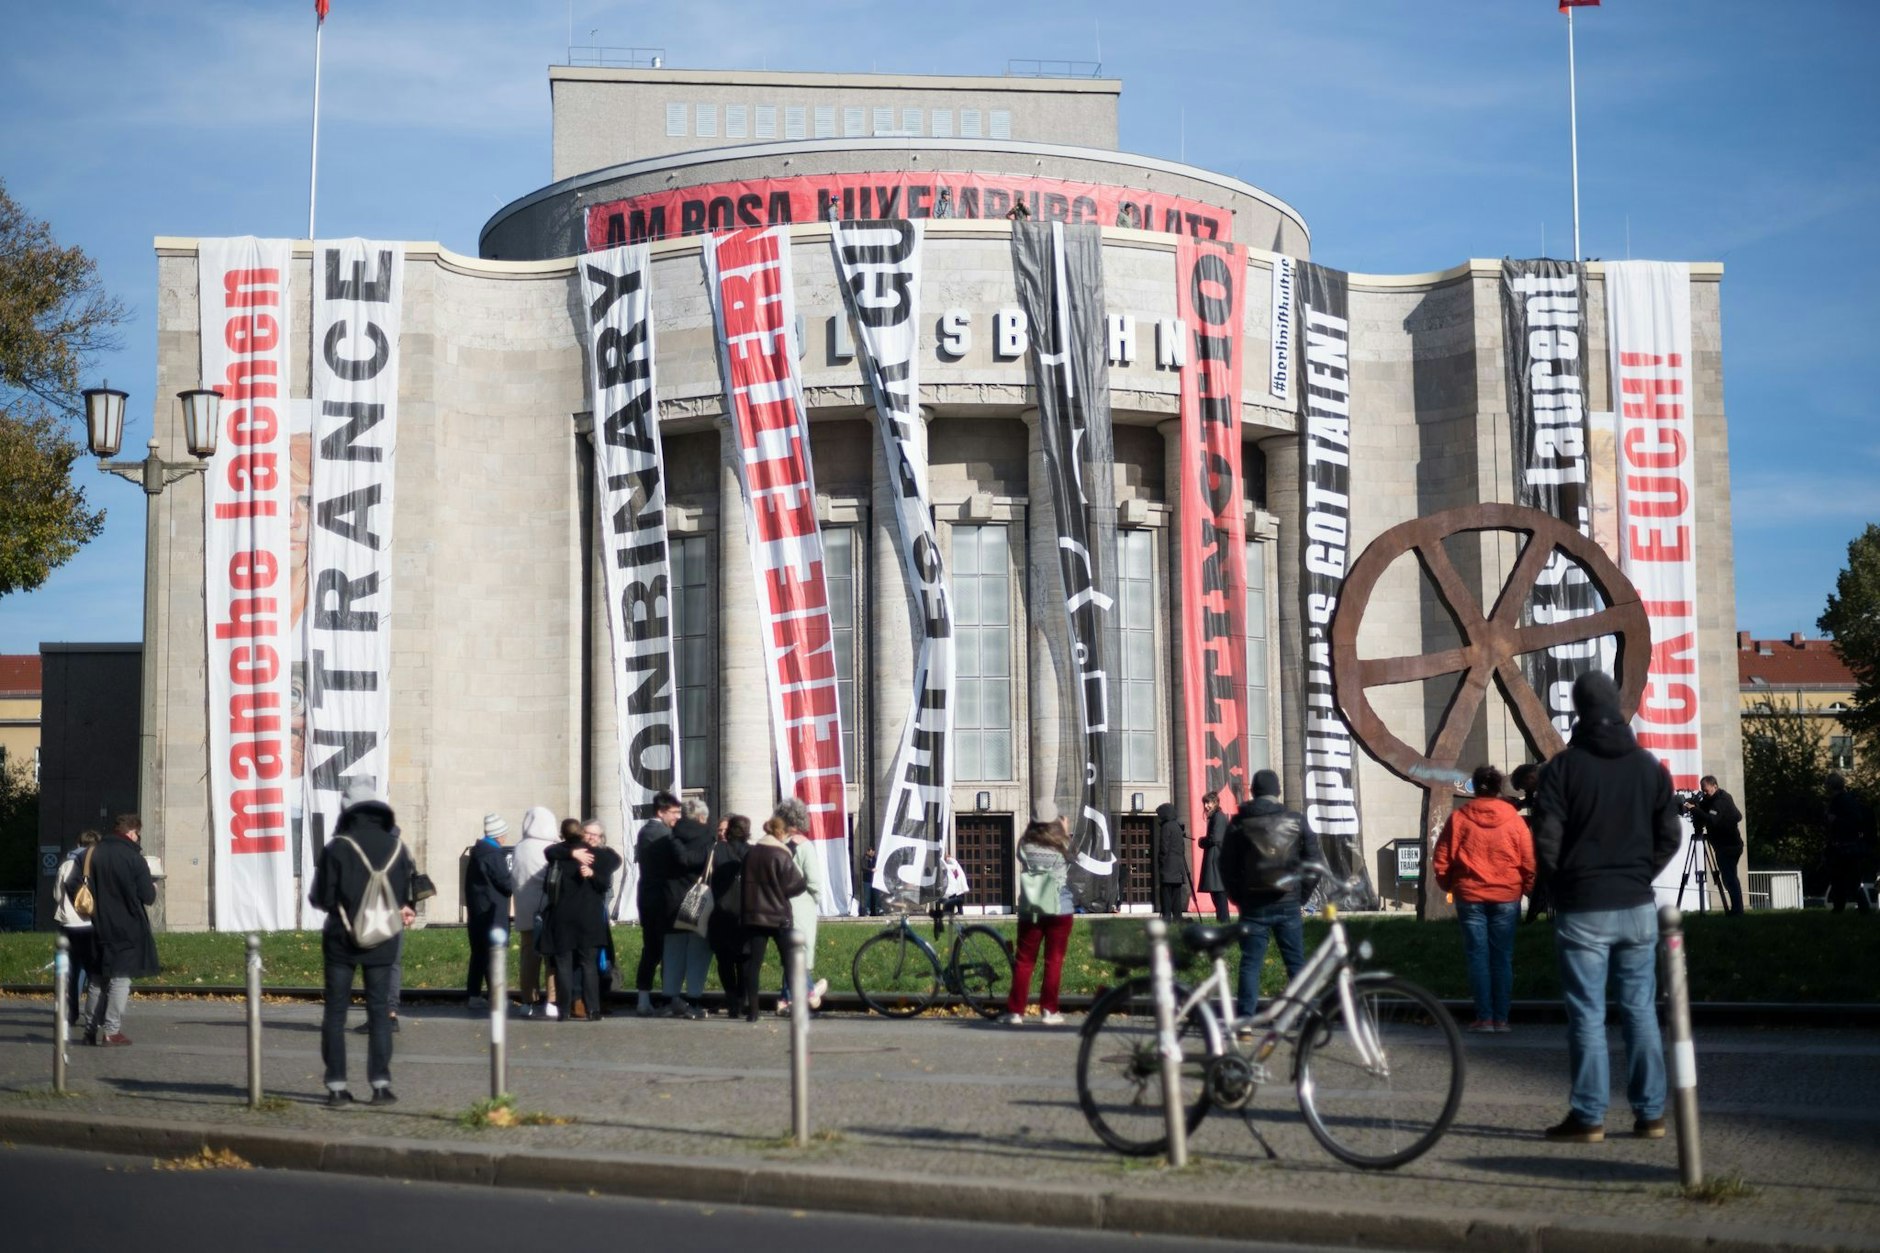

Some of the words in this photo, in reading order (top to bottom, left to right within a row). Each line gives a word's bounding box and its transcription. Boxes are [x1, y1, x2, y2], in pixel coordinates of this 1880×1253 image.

[607, 205, 665, 248] AM
[681, 190, 792, 237] ROSA
[212, 267, 280, 520] lachen
[712, 226, 817, 543] ELTERN
[1305, 302, 1349, 467] TALENT
[1512, 273, 1586, 486] Laurent
[1621, 351, 1691, 563] EUCH!
[312, 248, 393, 866] NTRANCE
[586, 263, 675, 821] ONBINARY
[913, 530, 951, 639] ES
[1191, 237, 1243, 812] XTINCTIO
[1306, 480, 1349, 579] GOT
[215, 549, 286, 855] manche
[765, 559, 845, 841] DEINE
[883, 668, 949, 905] GEHT
